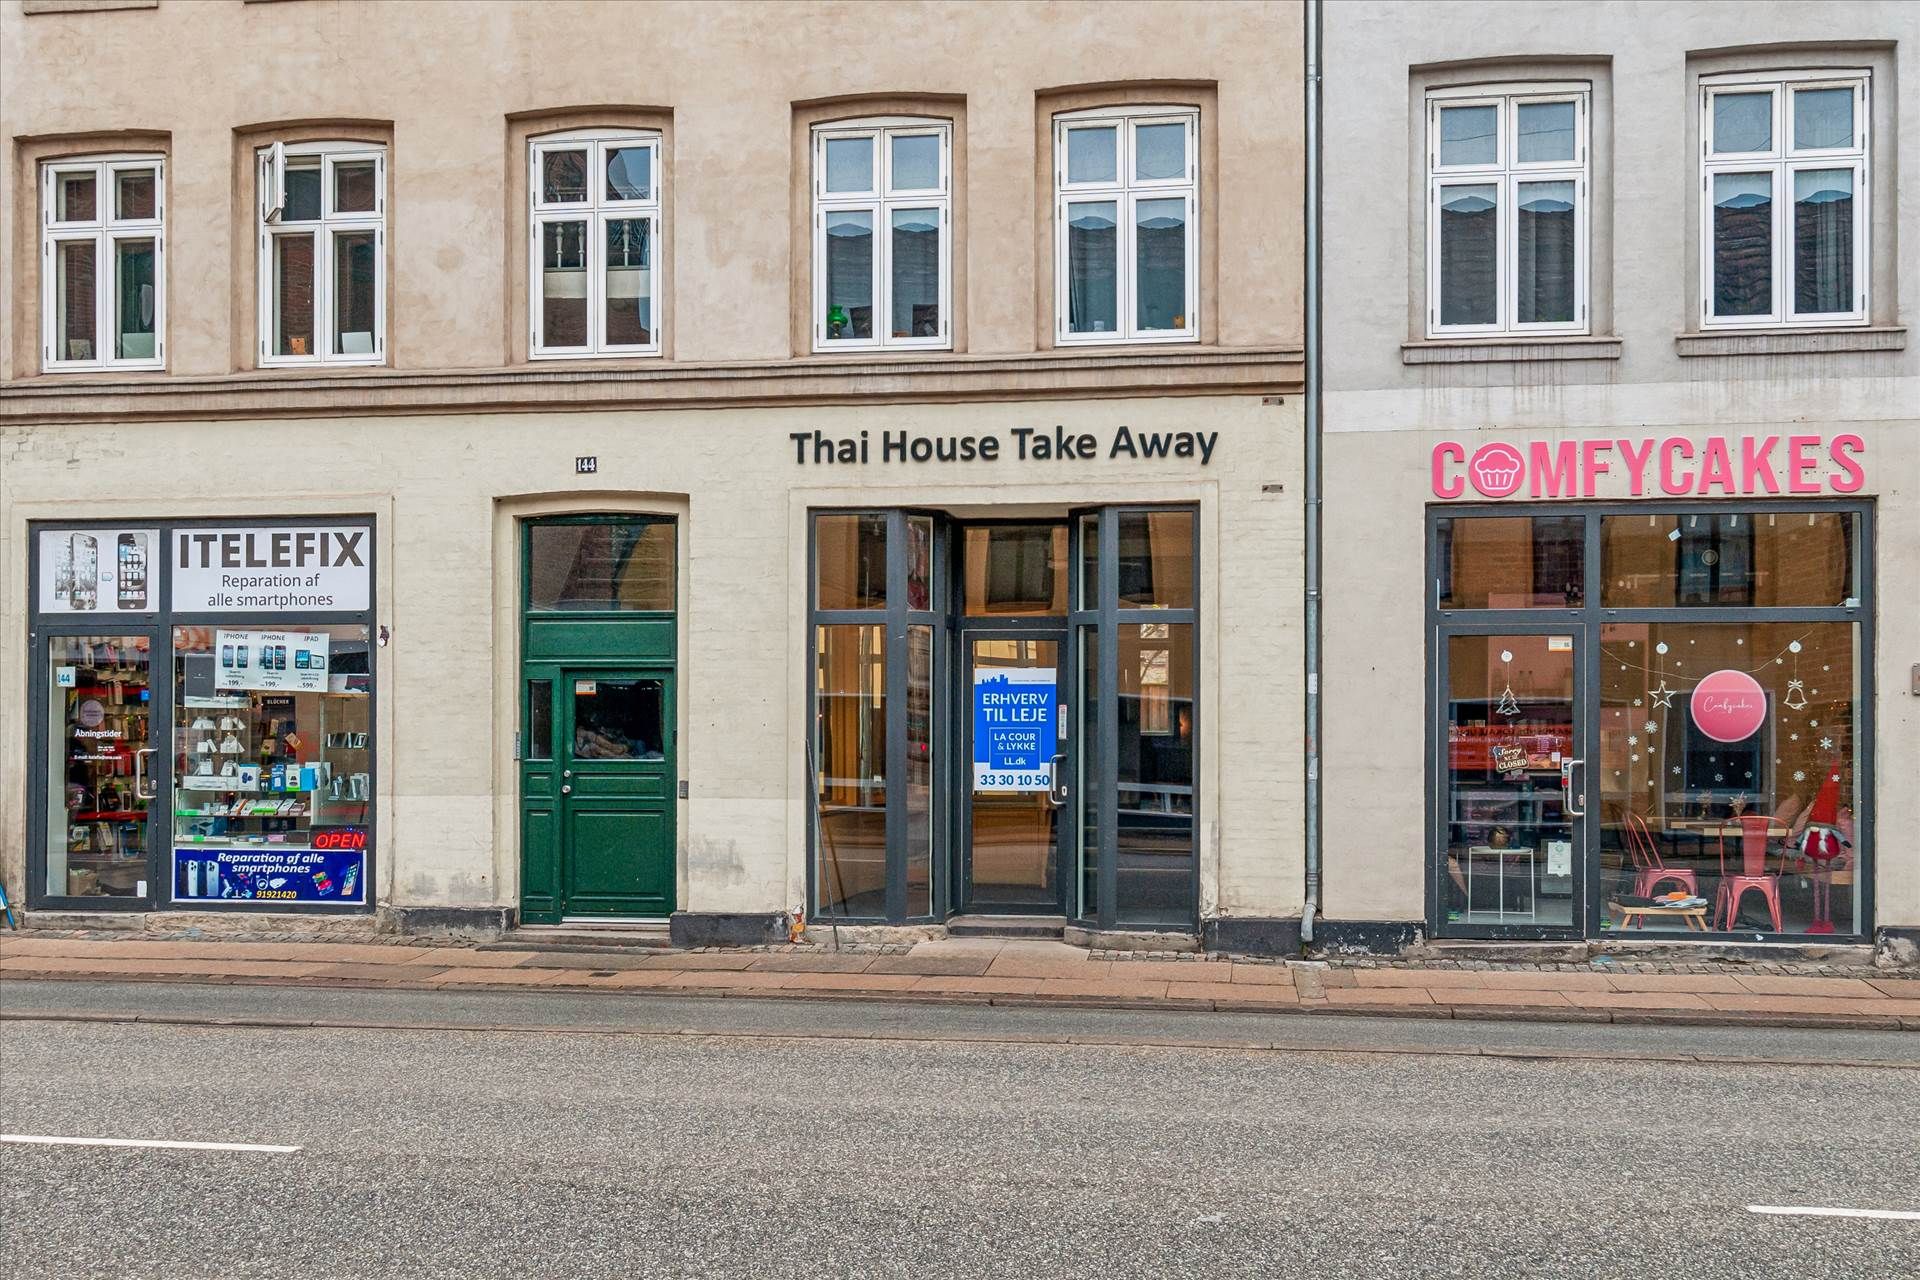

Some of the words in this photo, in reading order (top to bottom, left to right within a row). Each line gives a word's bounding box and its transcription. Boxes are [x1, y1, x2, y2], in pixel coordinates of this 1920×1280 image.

[790, 430, 869, 465] Thai
[882, 429, 1000, 463] House
[1010, 425, 1097, 461] Take
[1110, 425, 1219, 466] Away
[577, 459, 595, 471] 144
[180, 532, 365, 569] ITELEFIX
[222, 574, 300, 591] Reparation
[305, 573, 320, 587] af
[208, 593, 233, 607] alle
[237, 593, 333, 610] smartphones
[982, 693, 1048, 705] ERHVERV
[983, 708, 1008, 722] TIL
[1011, 708, 1048, 722] LEJE
[994, 733, 1006, 741] LA
[1008, 733, 1036, 741] COUR
[997, 742, 1005, 751] &
[1006, 742, 1036, 751] LYKKE
[1004, 757, 1026, 765] LL.dk
[1499, 759, 1527, 769] CLOSED
[980, 774, 996, 786] 33
[998, 774, 1014, 786] 30
[1017, 774, 1032, 786] 10
[1034, 774, 1050, 786] 50
[315, 832, 366, 849] OPEN
[217, 852, 284, 866] Reparation
[286, 853, 300, 867] af
[301, 853, 325, 864] alle
[232, 863, 310, 875] smartphones
[256, 890, 297, 900] 91921420
